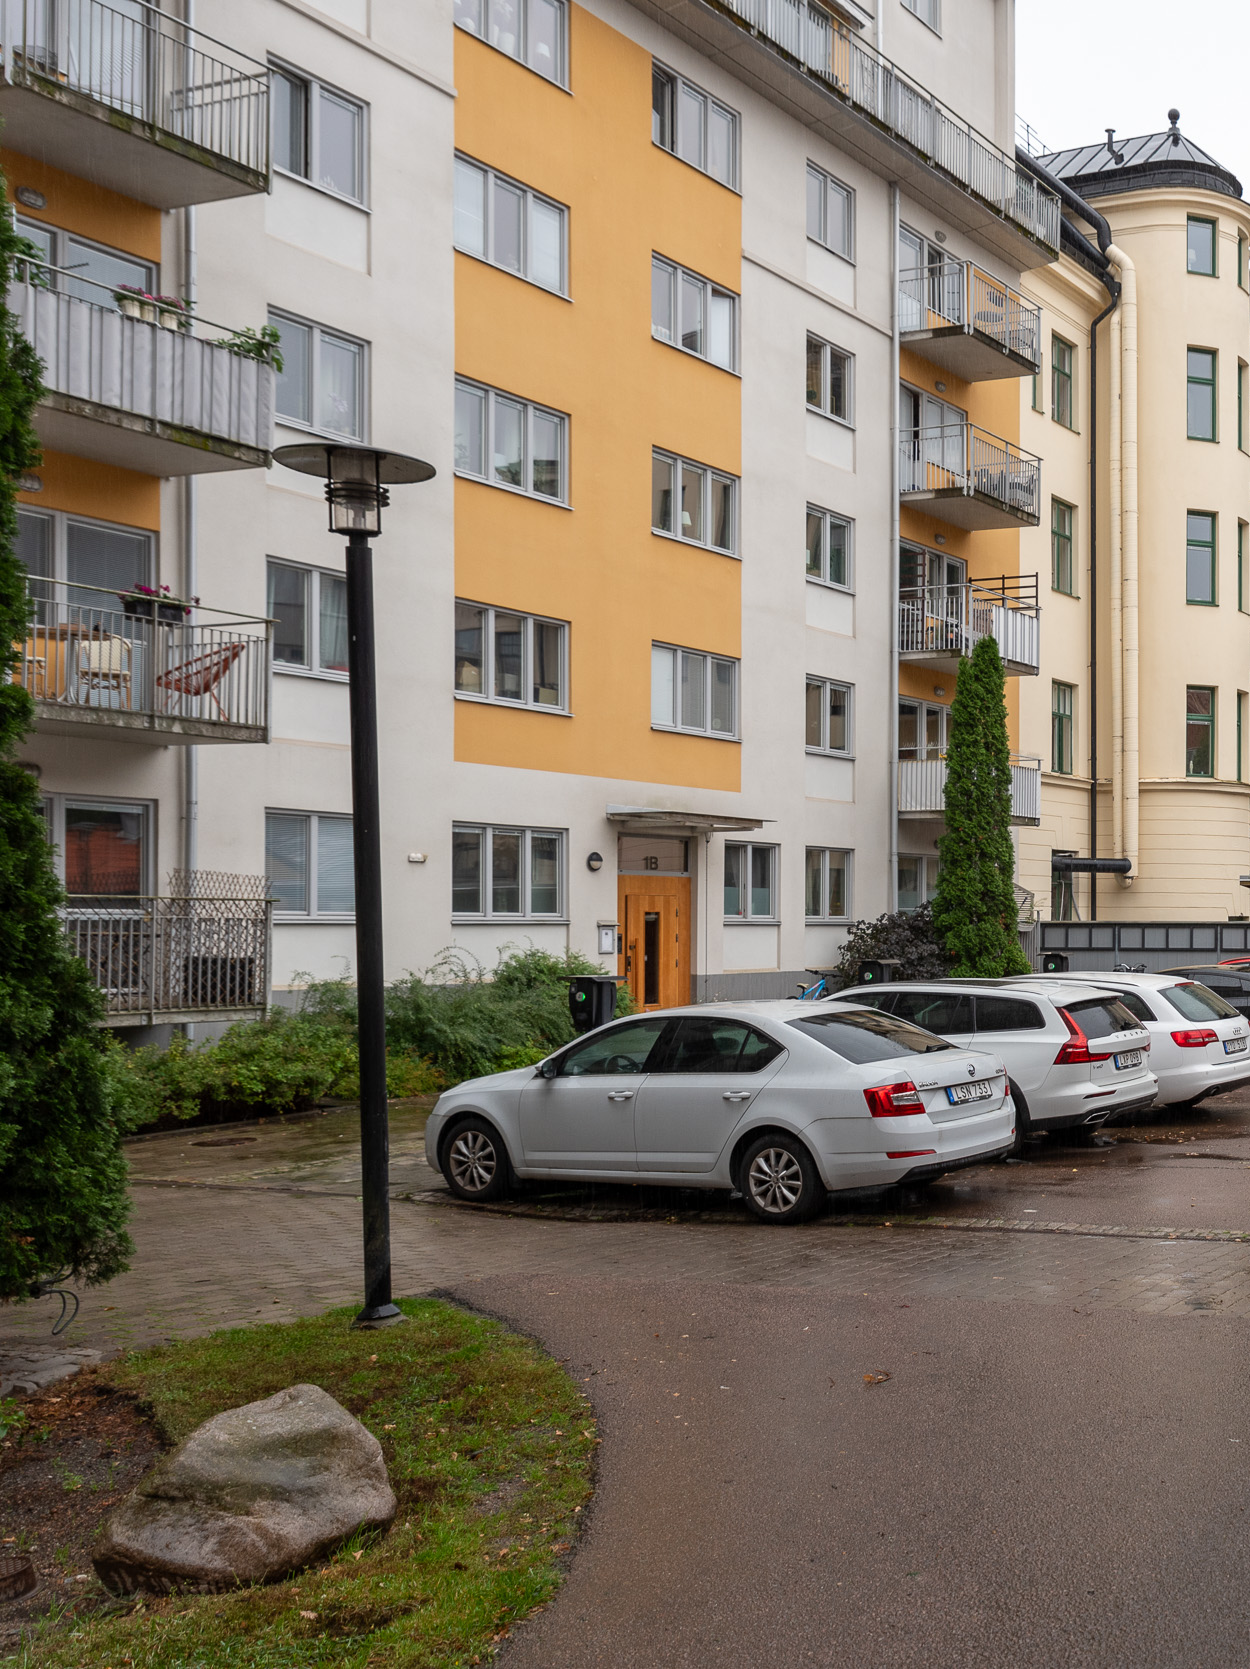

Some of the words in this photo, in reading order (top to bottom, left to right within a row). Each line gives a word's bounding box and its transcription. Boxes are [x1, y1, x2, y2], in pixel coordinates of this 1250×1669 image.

[642, 855, 659, 870] 1B
[955, 1085, 972, 1100] LSN
[972, 1082, 988, 1096] 733
